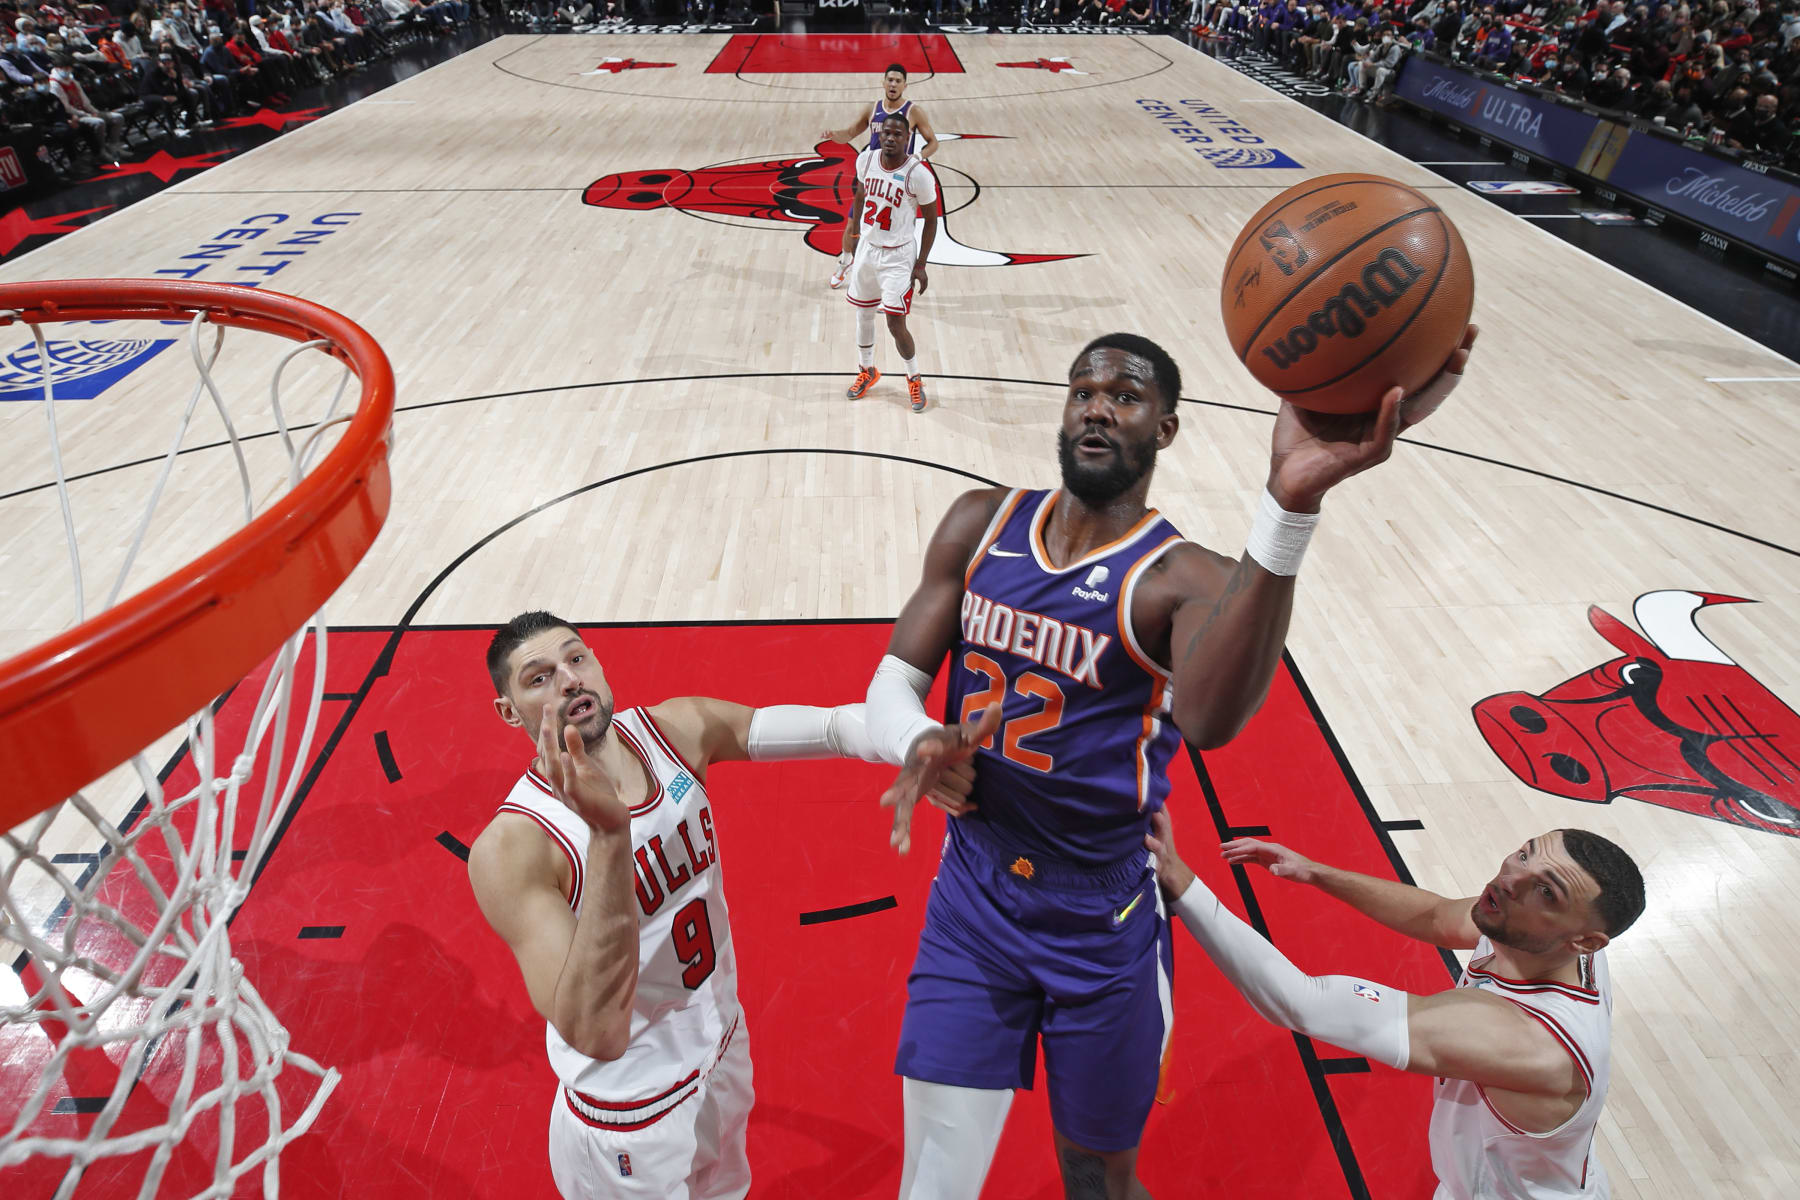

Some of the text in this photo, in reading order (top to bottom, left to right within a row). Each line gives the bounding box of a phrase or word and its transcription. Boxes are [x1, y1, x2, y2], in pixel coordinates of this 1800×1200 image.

[1135, 99, 1214, 143] CENTER
[1179, 99, 1265, 144] UNITED
[1422, 76, 1544, 139] Michelob ULTRA
[863, 200, 893, 232] 24
[864, 177, 905, 208] BULLS
[1666, 167, 1778, 223] Michelob
[153, 213, 290, 279] CENT
[217, 212, 363, 288] UNIT
[1262, 247, 1425, 370] Wilson
[1071, 586, 1109, 602] PayPal
[960, 651, 1066, 773] 22
[633, 806, 717, 917] ULLS
[671, 897, 717, 991] 9
